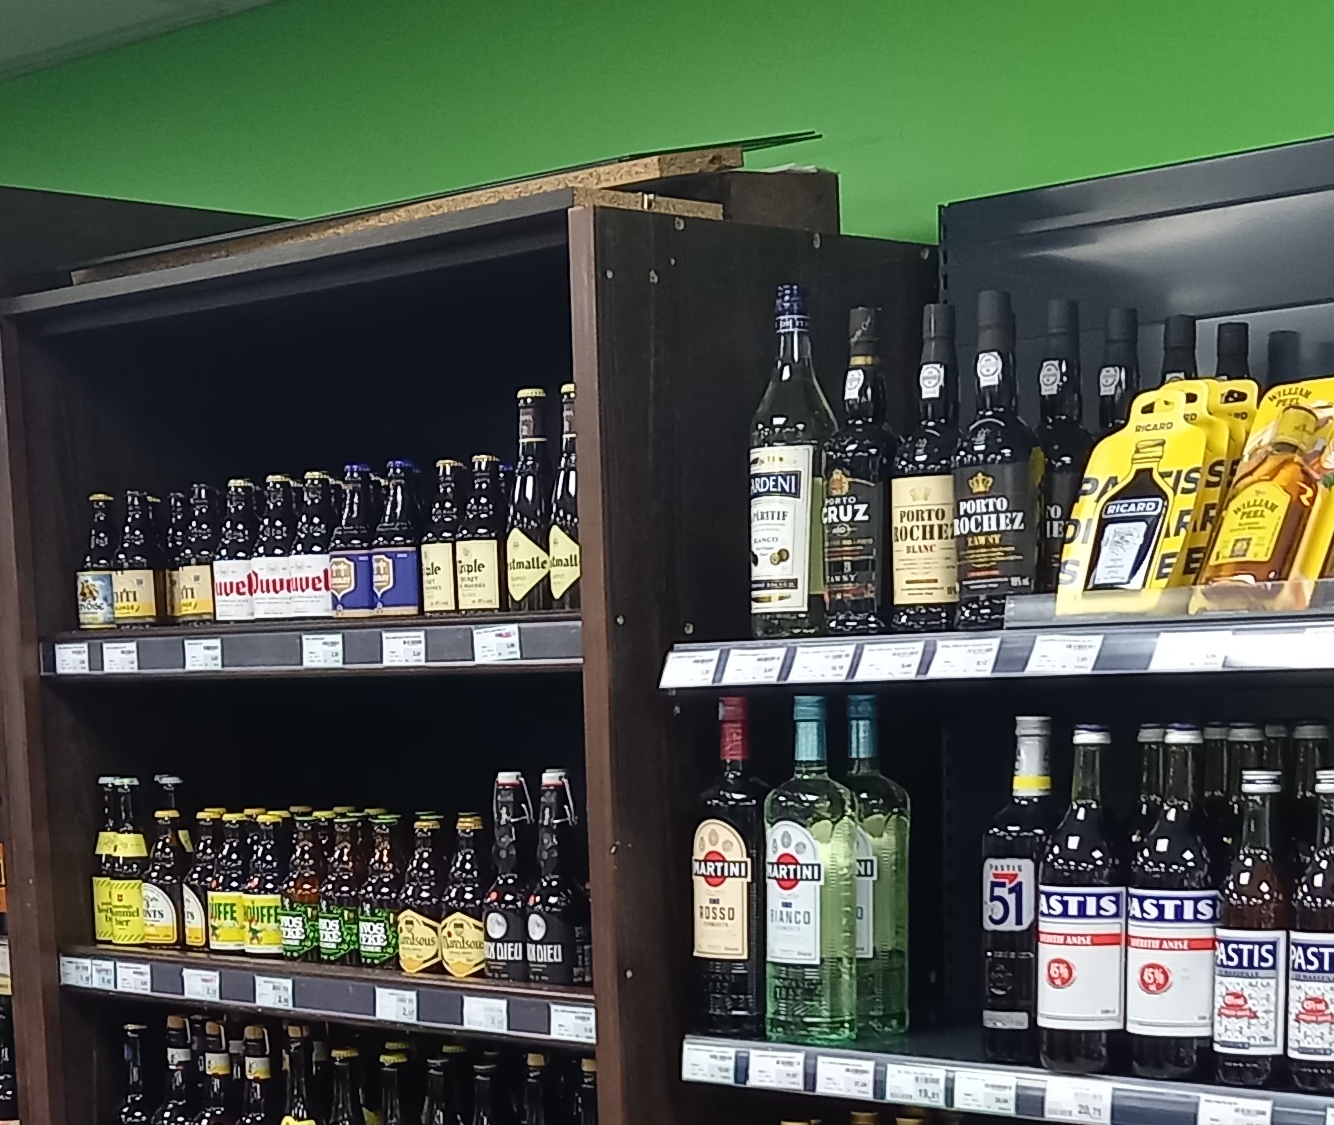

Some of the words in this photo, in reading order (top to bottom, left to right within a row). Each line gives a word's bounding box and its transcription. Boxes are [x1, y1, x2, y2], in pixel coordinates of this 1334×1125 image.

[1267, 388, 1313, 402] WILLIAM
[1275, 397, 1300, 408] PEEL
[1135, 422, 1173, 433] RICARD
[959, 497, 1009, 515] PORTO
[1106, 501, 1157, 515] RICARD
[1232, 499, 1280, 515] WILLIAM
[823, 504, 869, 524] CRUZ
[899, 508, 946, 523] PORTO
[1240, 509, 1266, 520] PEEL
[906, 544, 937, 554] BLANC
[509, 556, 548, 571] stmalle
[989, 864, 1023, 872] PASTIS
[988, 881, 1024, 926] 51
[1039, 895, 1117, 916] ASTIS
[1128, 899, 1214, 921] ASTIS
[142, 909, 164, 919] ONTS
[699, 906, 735, 921] ROSSO
[497, 942, 523, 961] DIEU
[537, 944, 562, 963] DIEU
